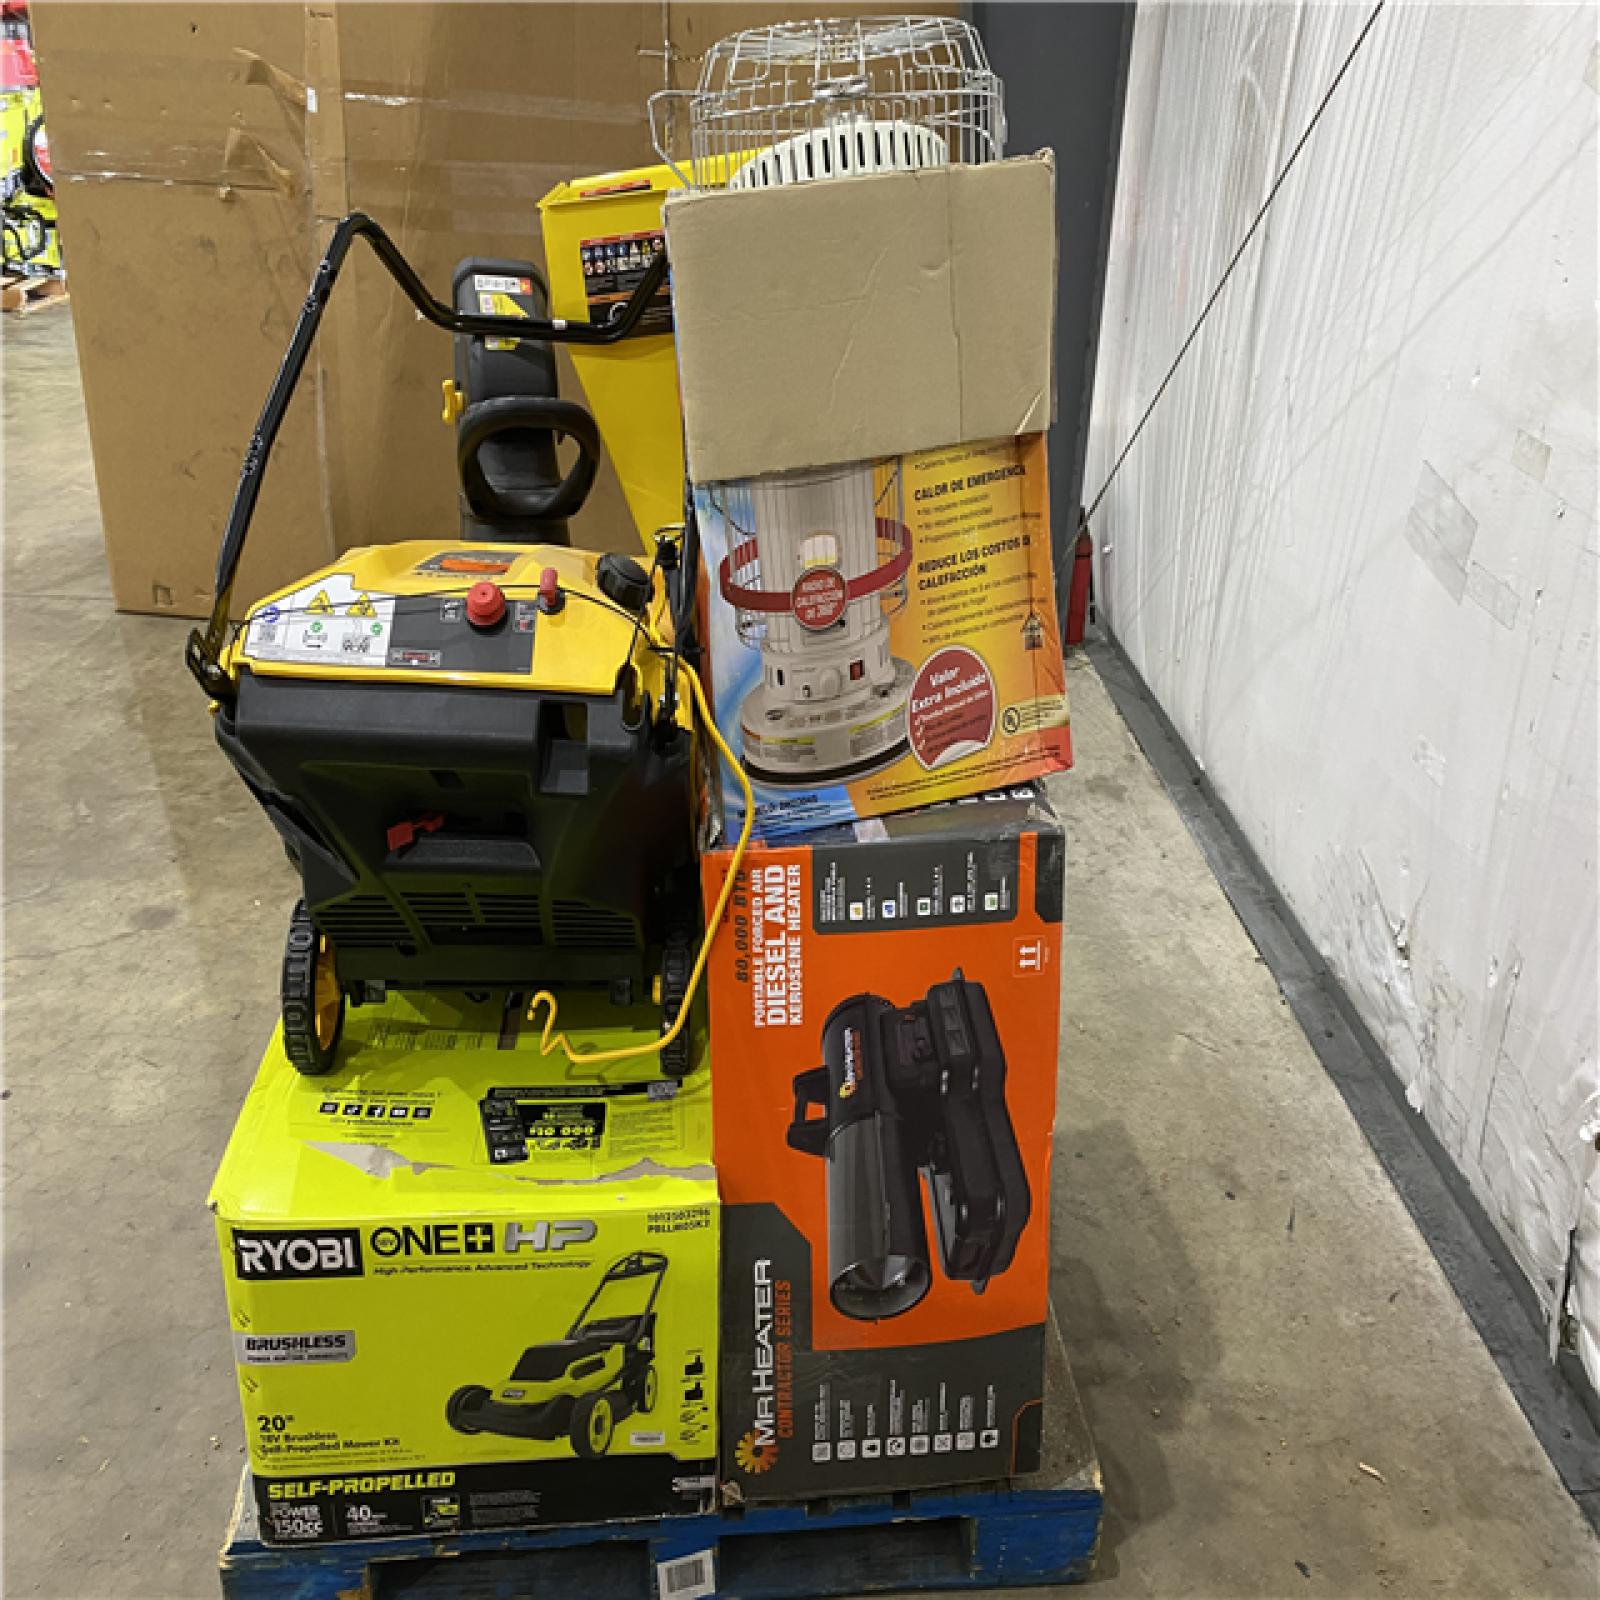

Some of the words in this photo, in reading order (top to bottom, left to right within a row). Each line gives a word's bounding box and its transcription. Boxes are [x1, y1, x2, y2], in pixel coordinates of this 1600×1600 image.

[914, 483, 948, 501] CALOR
[952, 479, 964, 491] DE
[918, 554, 958, 574] REDUCE
[959, 547, 980, 563] LOS
[982, 537, 1021, 557] COSTOS
[929, 667, 961, 688] Valor
[911, 693, 942, 714] Extra
[752, 869, 763, 893] AIR
[764, 865, 786, 924] AND
[787, 864, 801, 931] HEATER
[752, 897, 764, 953] FORCED
[752, 958, 766, 1028] PORTABLE
[764, 931, 786, 1026] DIESEL
[788, 936, 803, 1026] KEROSENE
[237, 1237, 357, 1273] RYOBI
[503, 1219, 598, 1253] HP
[775, 1280, 792, 1336] SERIES
[246, 1334, 346, 1351] BRUSHLESS
[776, 1342, 794, 1438] CONTRACTOR
[284, 1431, 338, 1443] Brushless
[343, 1440, 380, 1449] Mower
[267, 1472, 456, 1500] SELF-PROPELLED
[346, 1504, 372, 1521] 40
